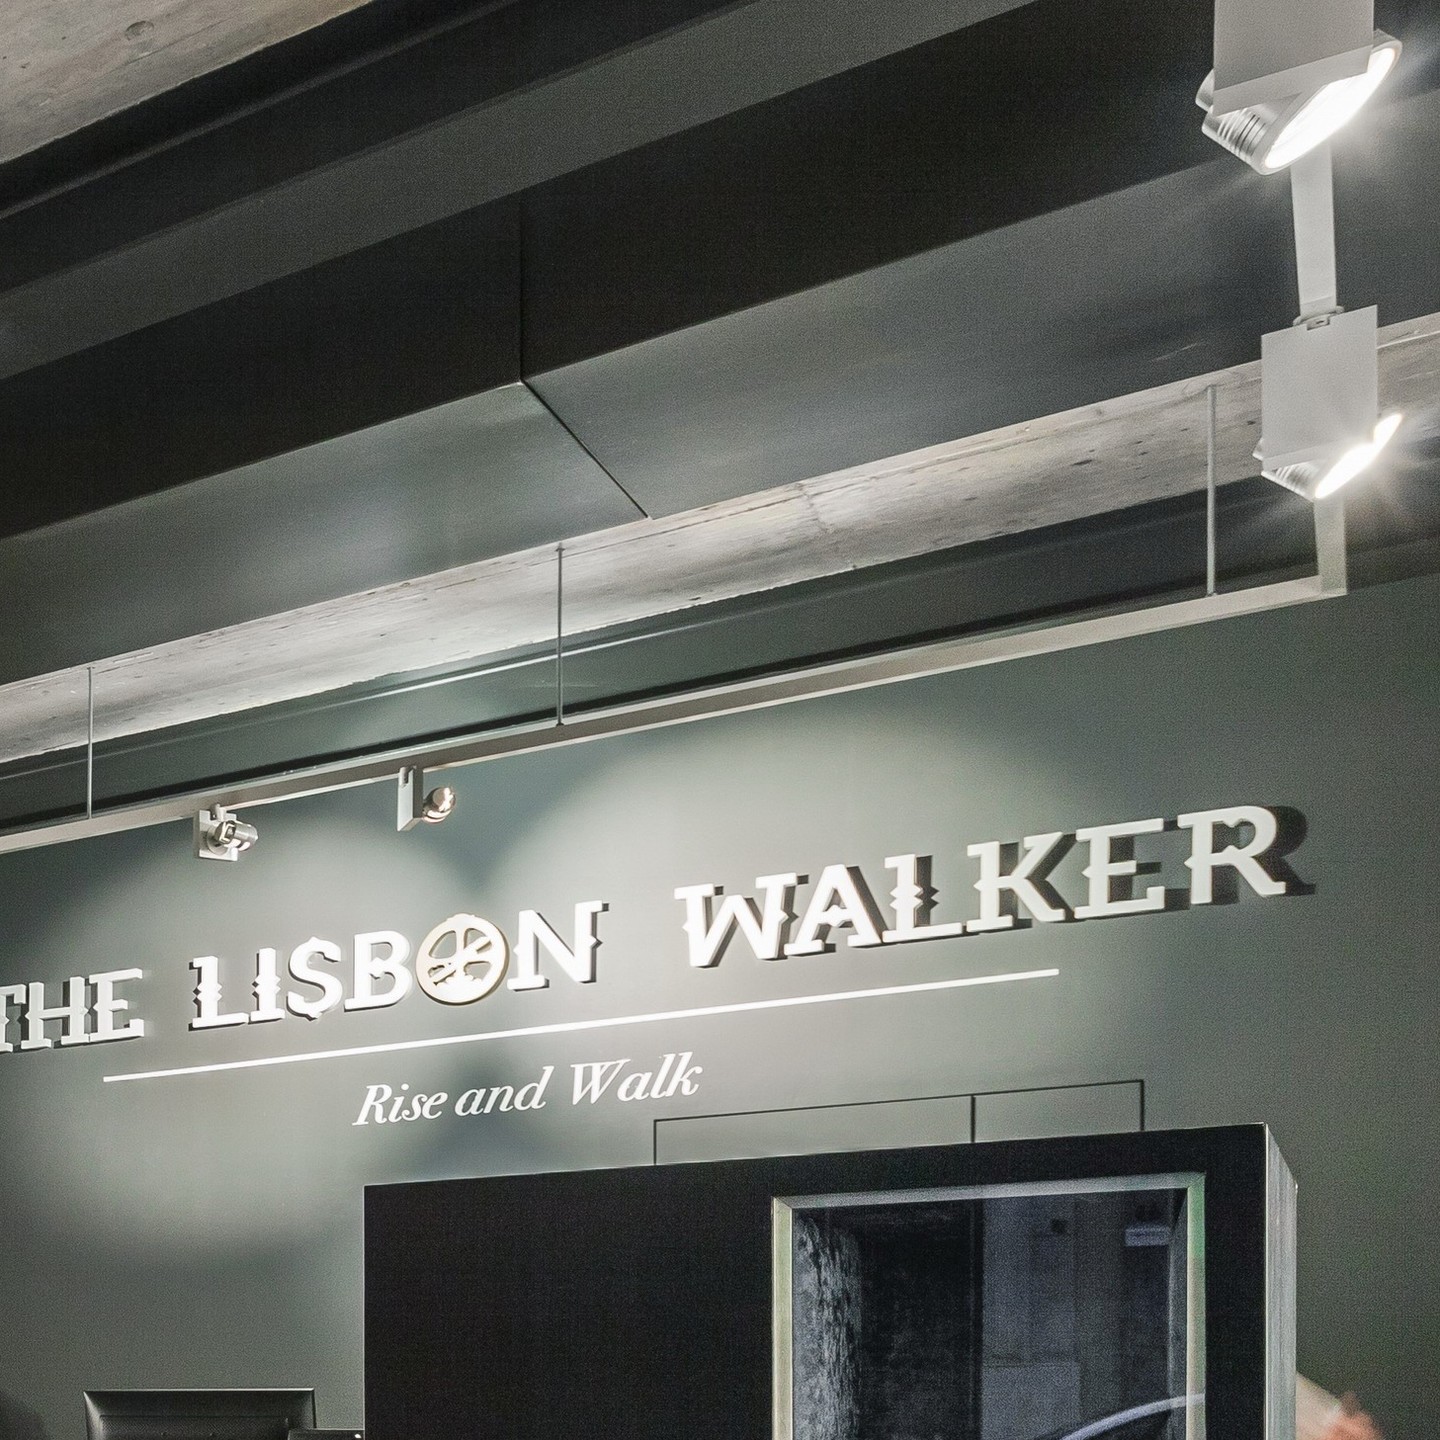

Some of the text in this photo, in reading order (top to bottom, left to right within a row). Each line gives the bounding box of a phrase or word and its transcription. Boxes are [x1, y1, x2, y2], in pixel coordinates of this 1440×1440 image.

[192, 900, 608, 1029] LISBON
[674, 805, 1287, 967] WALKER
[352, 1051, 703, 1126] Rise and Walk
